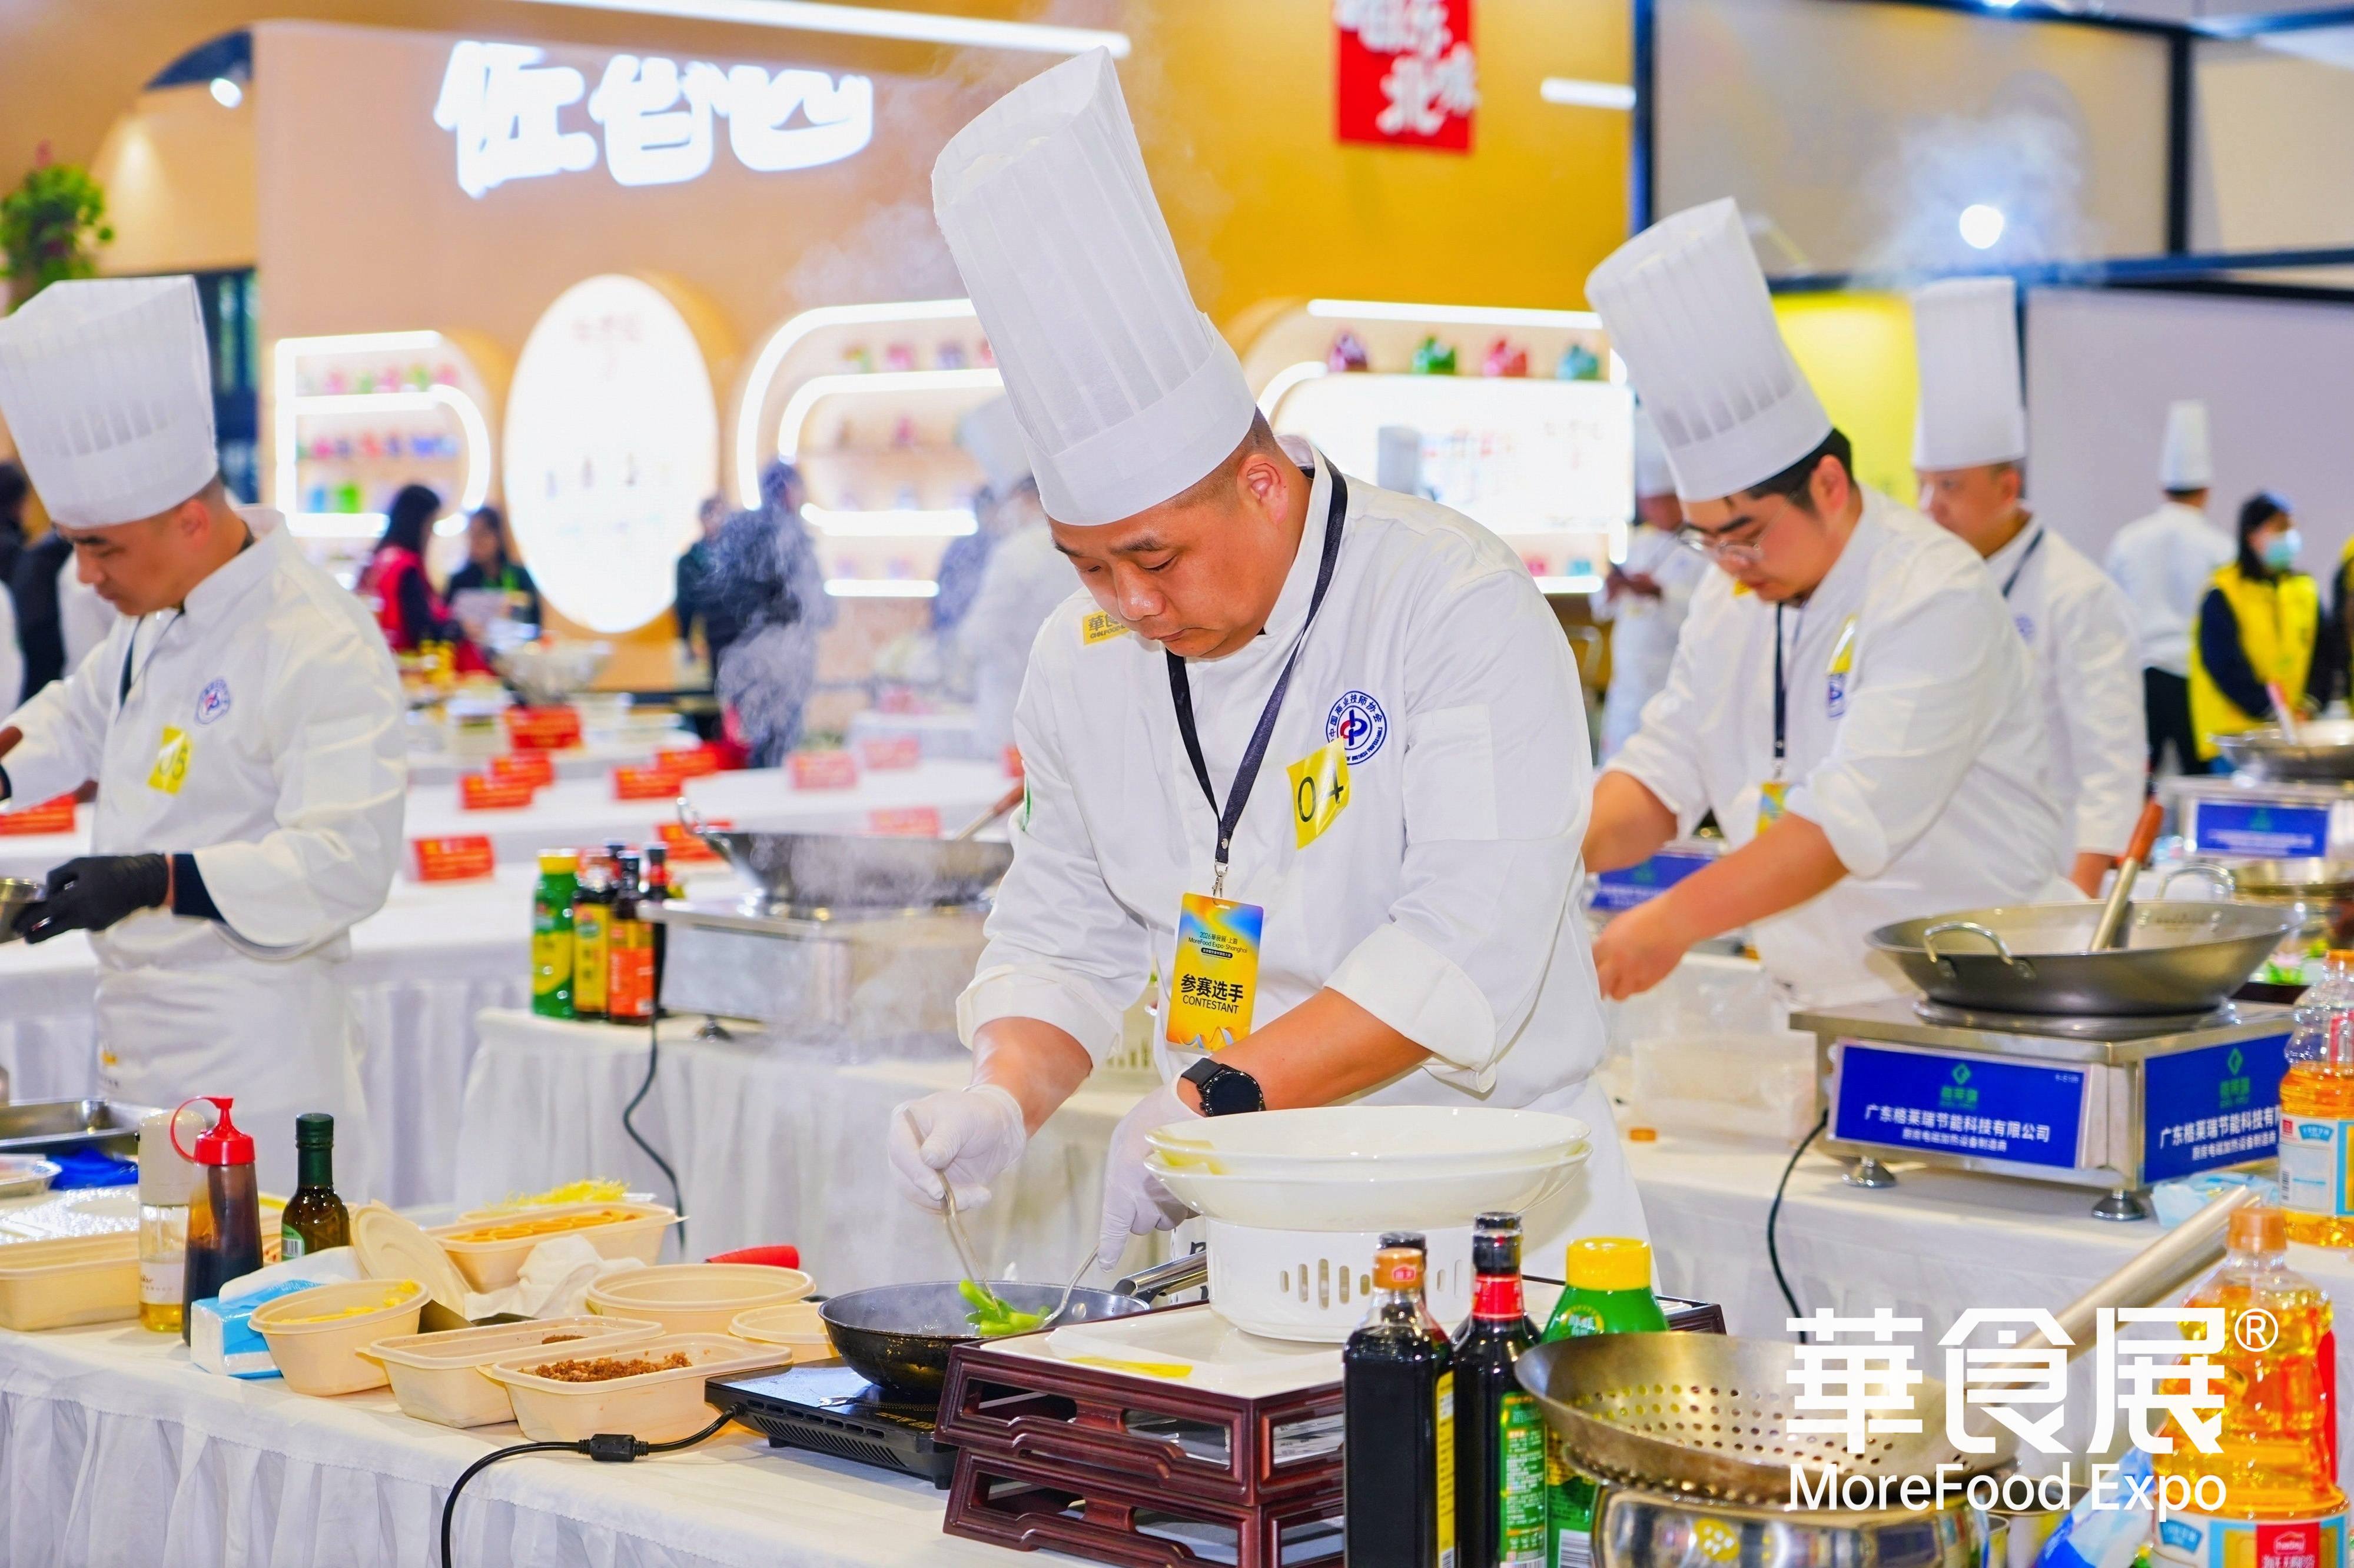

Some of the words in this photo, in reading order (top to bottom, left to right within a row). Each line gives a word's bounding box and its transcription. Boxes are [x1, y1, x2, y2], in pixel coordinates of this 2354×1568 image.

[1181, 974, 1243, 1002] 参赛选手
[1183, 995, 1239, 1014] CONTESTANT
